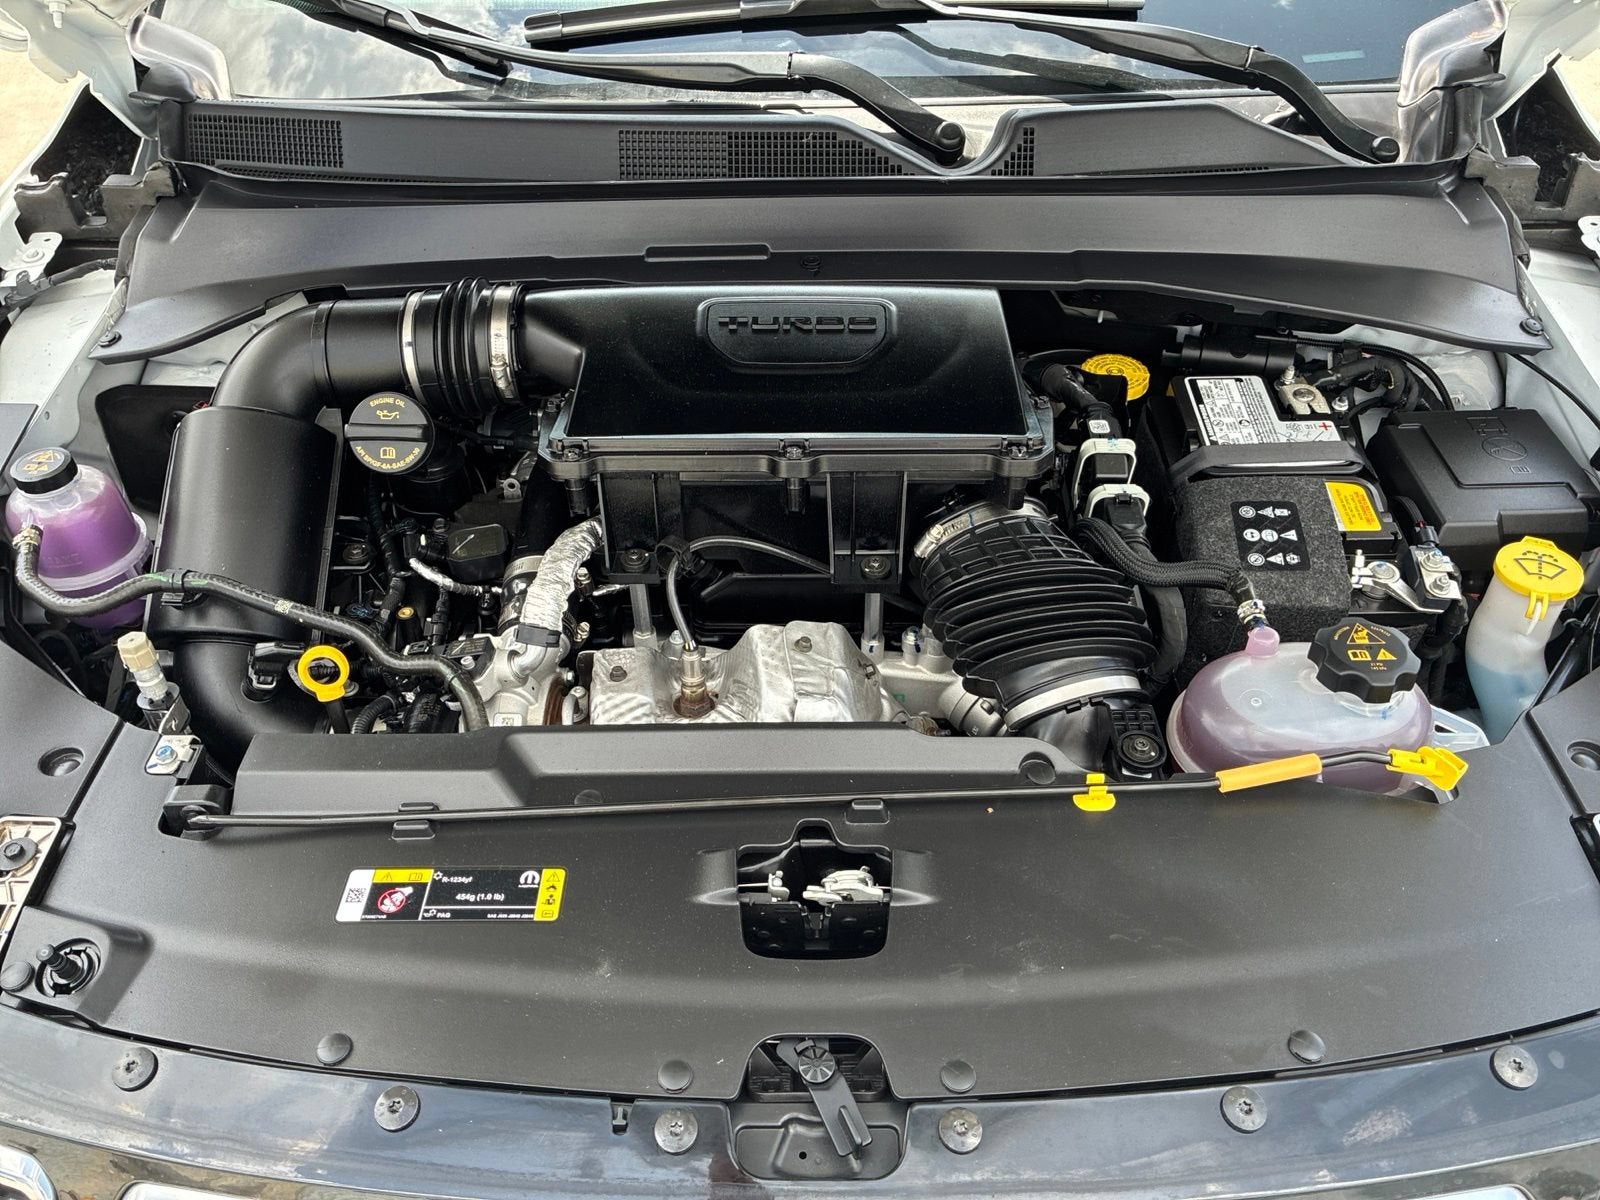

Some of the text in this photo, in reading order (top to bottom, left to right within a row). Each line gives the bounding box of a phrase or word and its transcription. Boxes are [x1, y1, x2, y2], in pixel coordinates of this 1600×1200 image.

[717, 315, 877, 332] TURBO
[369, 397, 406, 408] ENGINE OIL
[441, 876, 473, 884] R-1234yf
[455, 893, 505, 902] 454g (1.0 lb)
